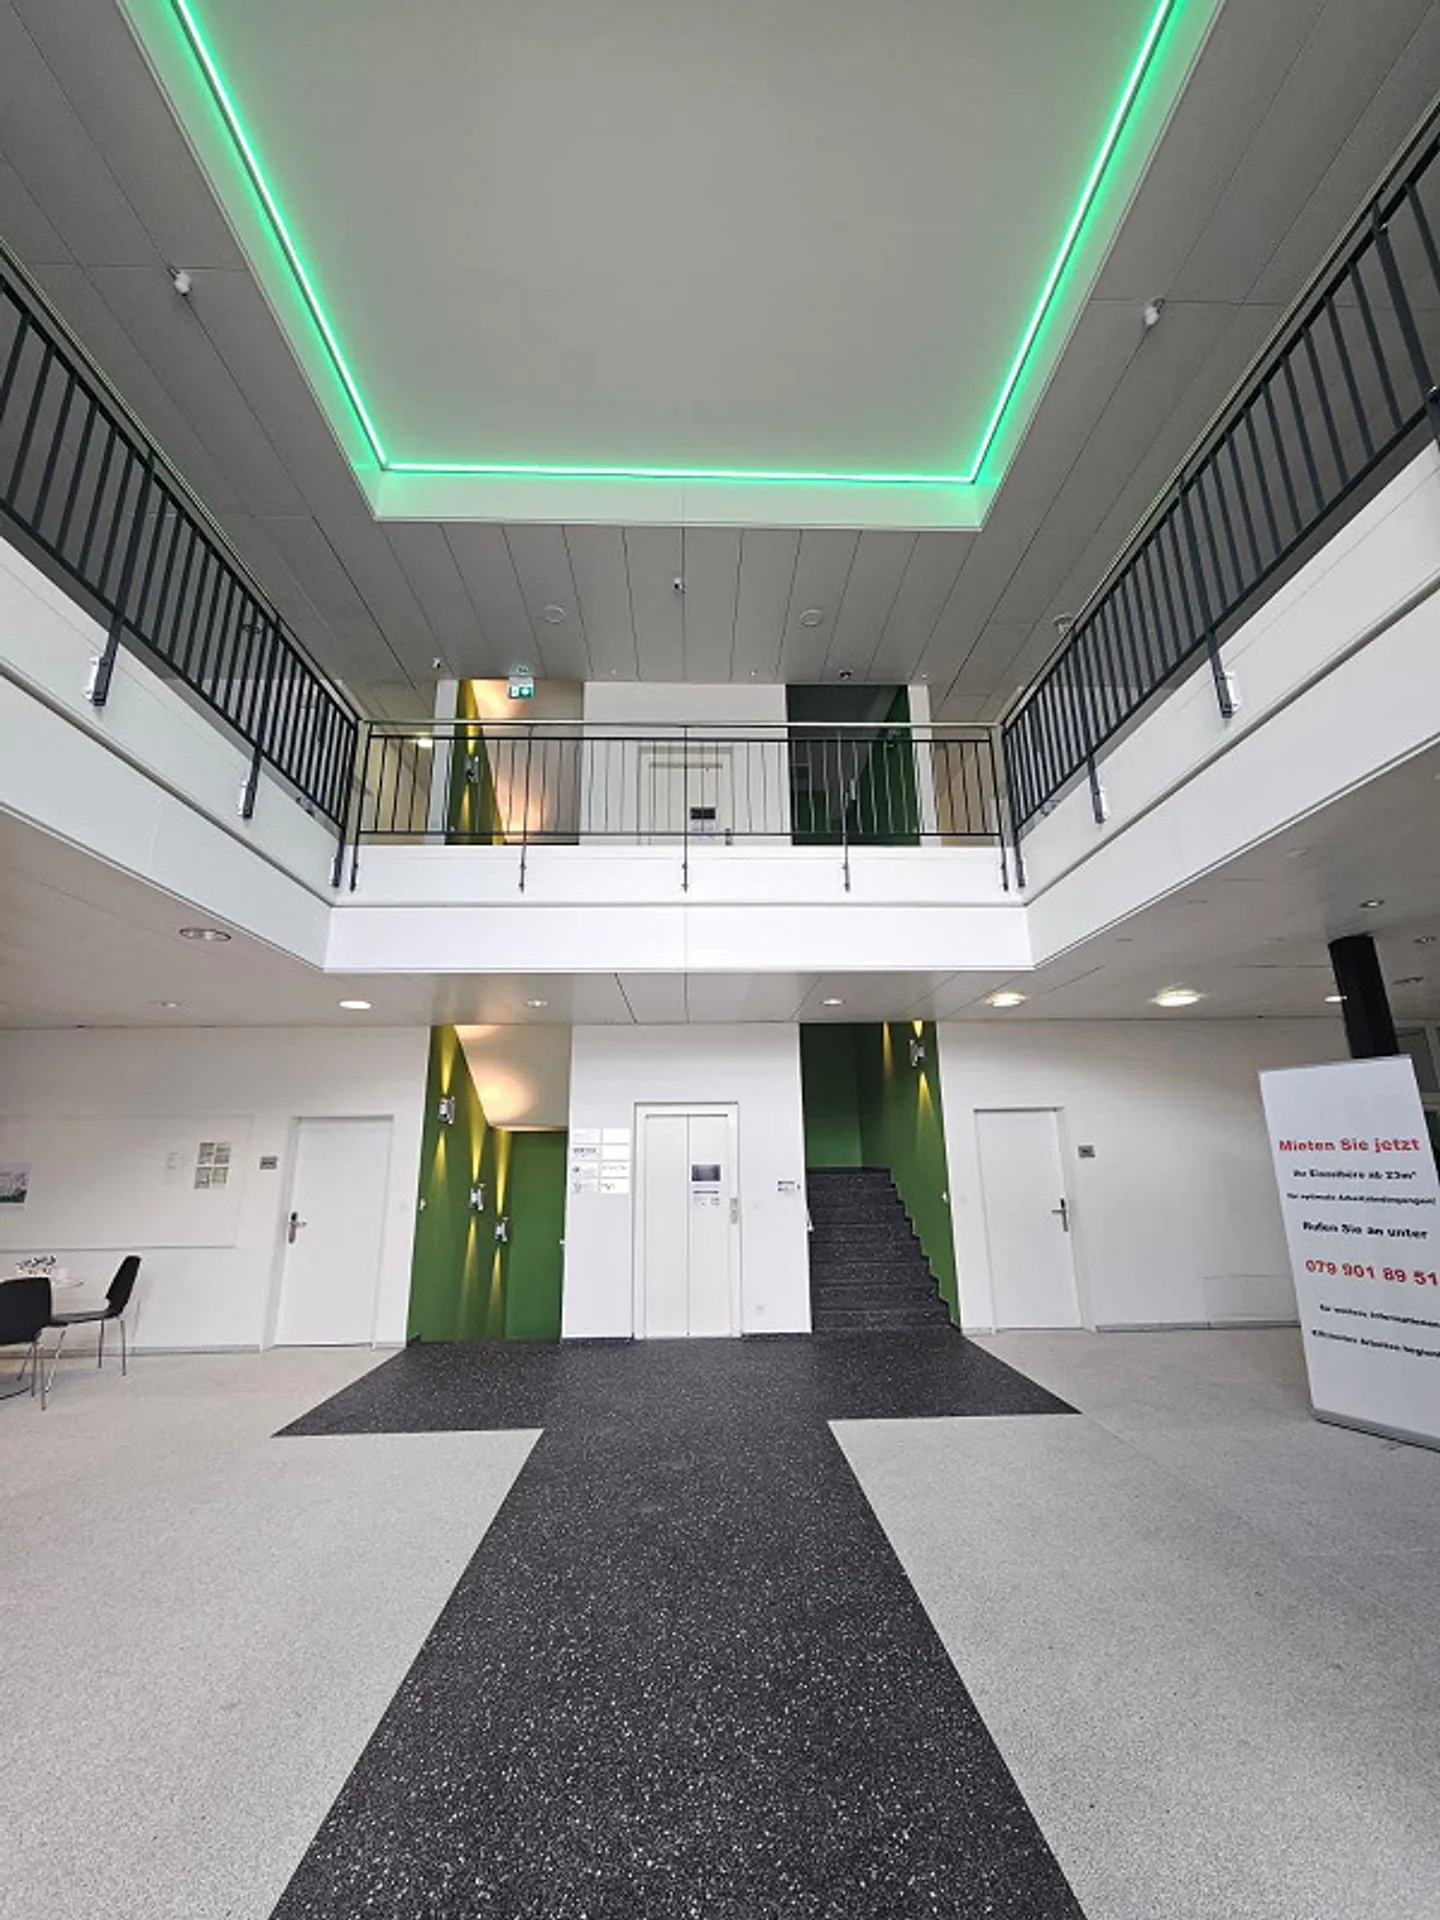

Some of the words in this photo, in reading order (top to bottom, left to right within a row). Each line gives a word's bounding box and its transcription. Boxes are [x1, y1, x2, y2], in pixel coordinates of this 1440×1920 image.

[1279, 1140, 1335, 1151] Mieten
[1340, 1138, 1369, 1151] Sie
[1375, 1138, 1420, 1153] jetzt
[1303, 1221, 1338, 1233] Rufen
[1341, 1224, 1362, 1234] Sie
[1367, 1227, 1384, 1235] an
[1388, 1228, 1428, 1239] unter
[1305, 1259, 1337, 1275] 079
[1342, 1263, 1375, 1279] 901
[1383, 1267, 1407, 1283] 89
[1413, 1270, 1438, 1287] 51
